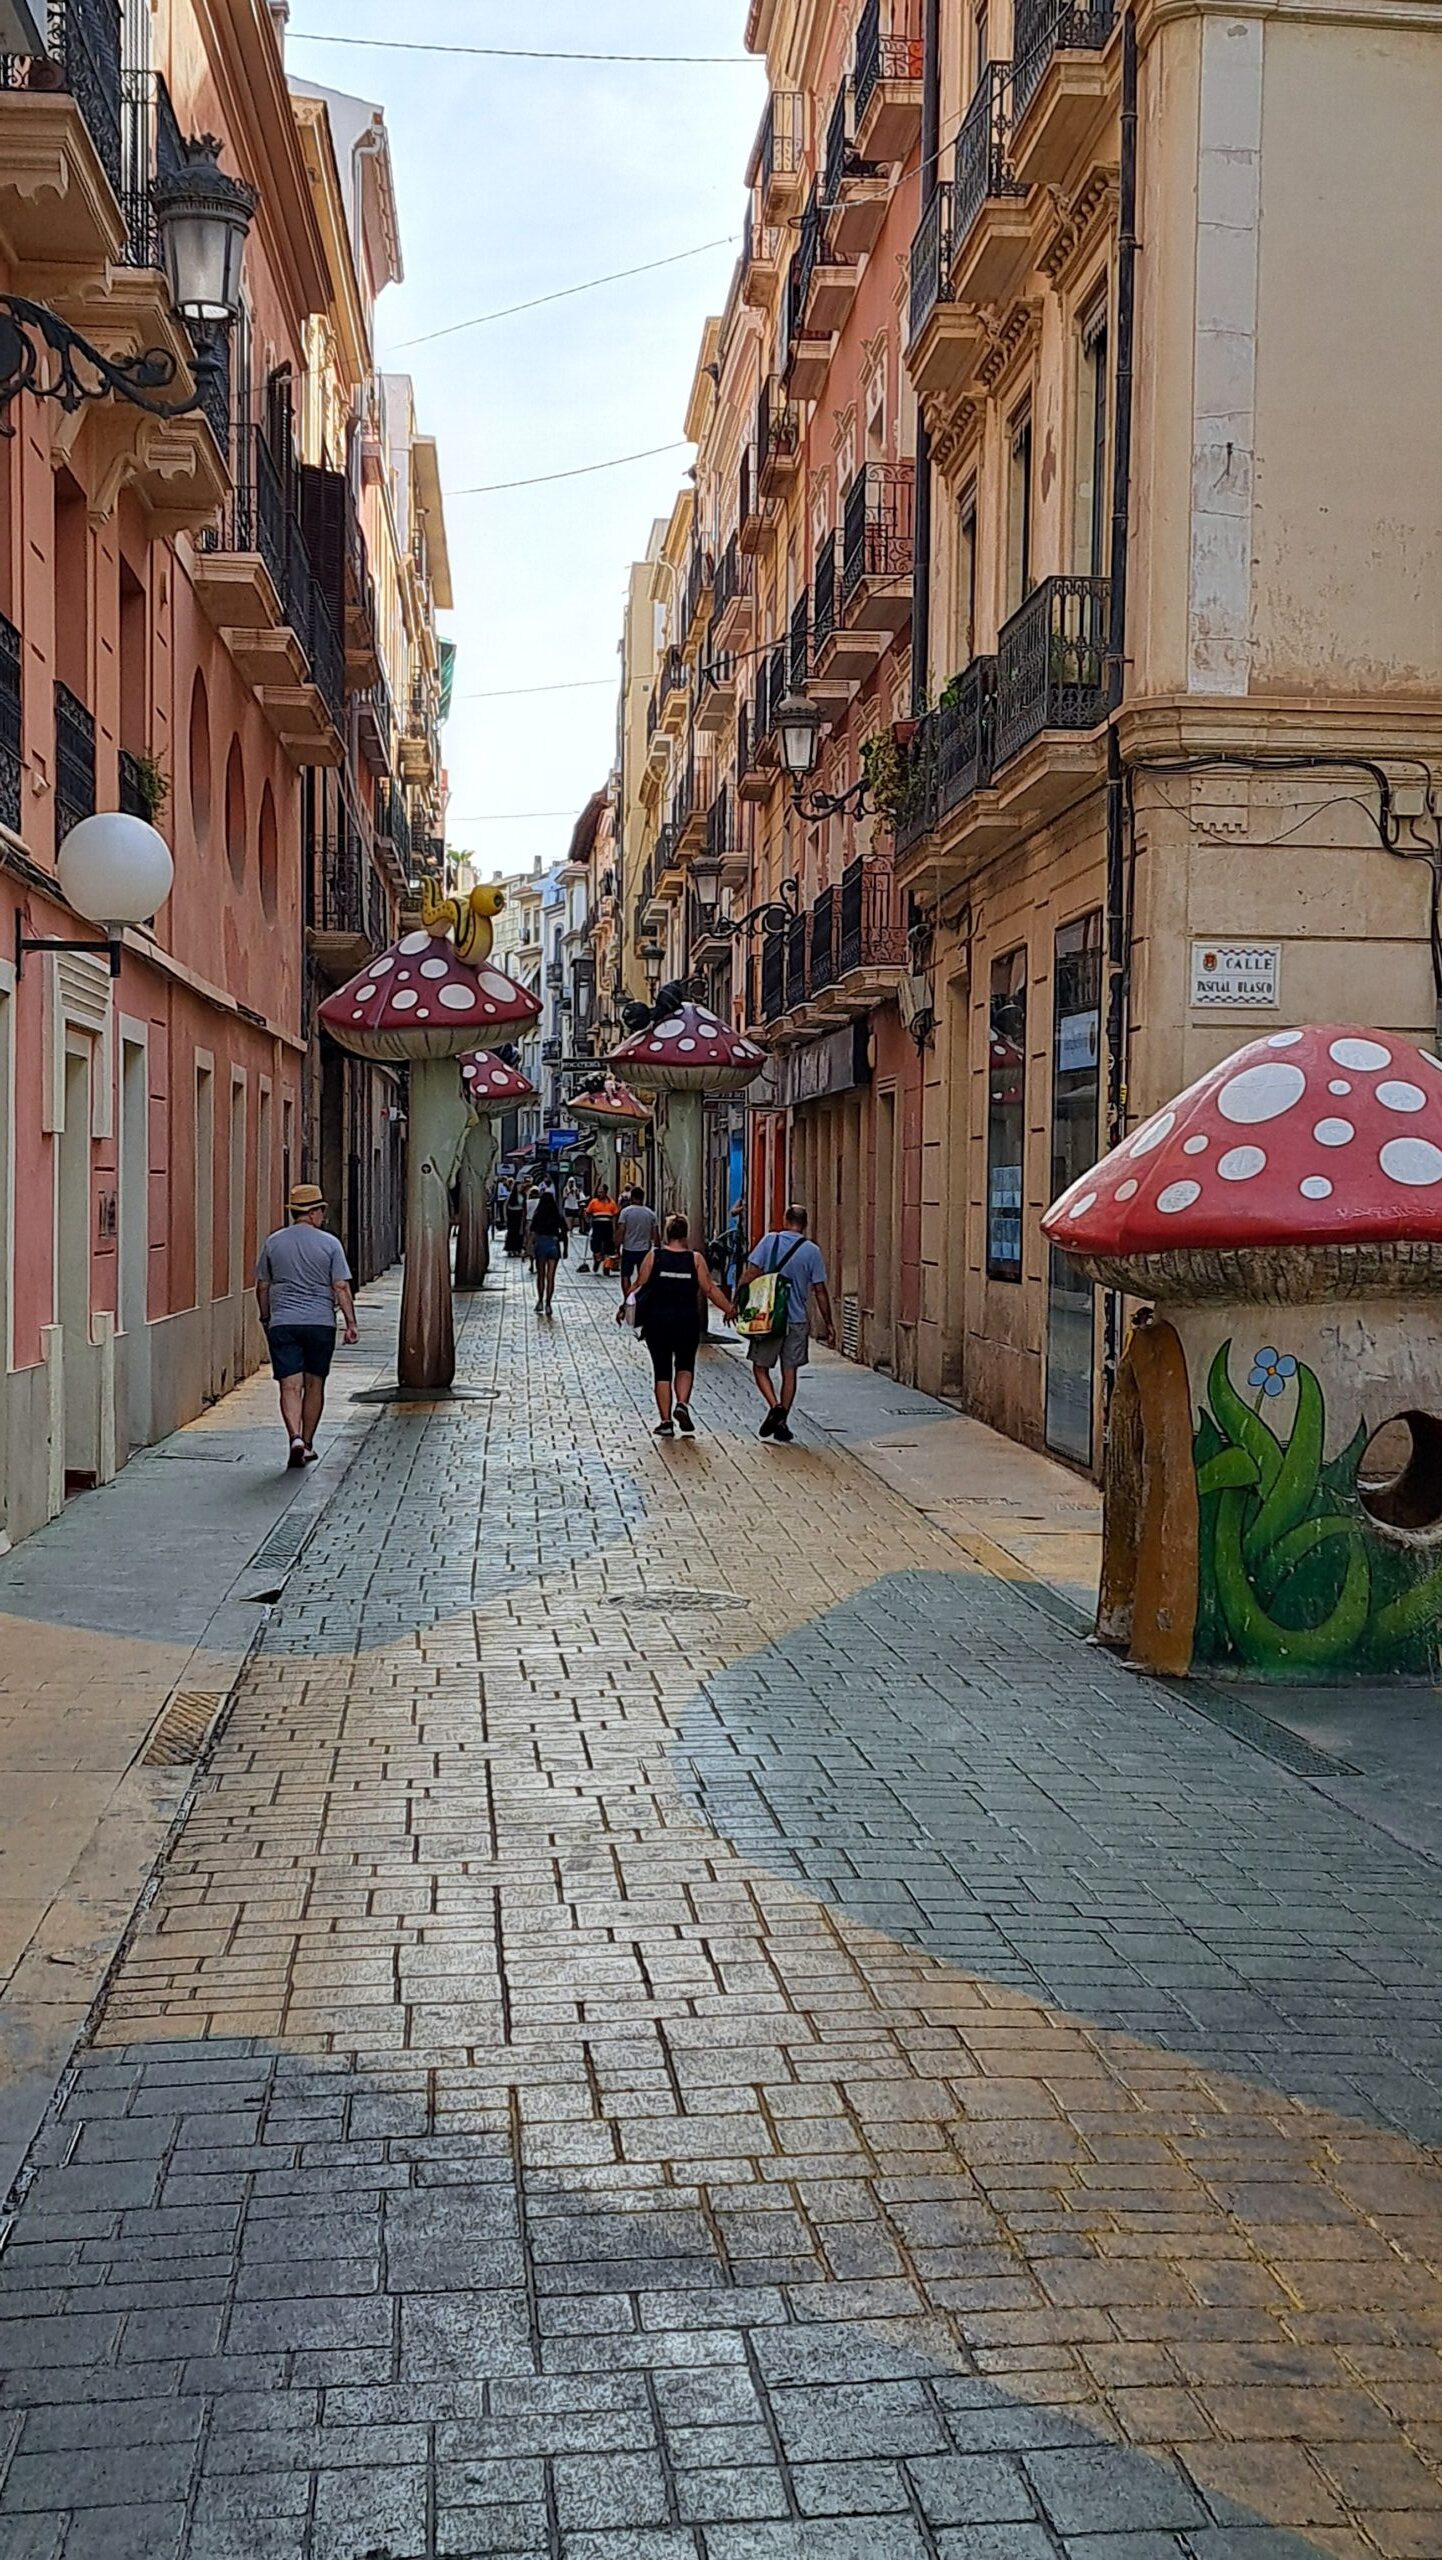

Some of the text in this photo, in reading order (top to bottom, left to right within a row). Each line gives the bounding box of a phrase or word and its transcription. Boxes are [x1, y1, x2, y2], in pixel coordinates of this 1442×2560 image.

[1225, 957, 1273, 970] CALLE
[1196, 980, 1273, 994] PASCUAL BLASCO
